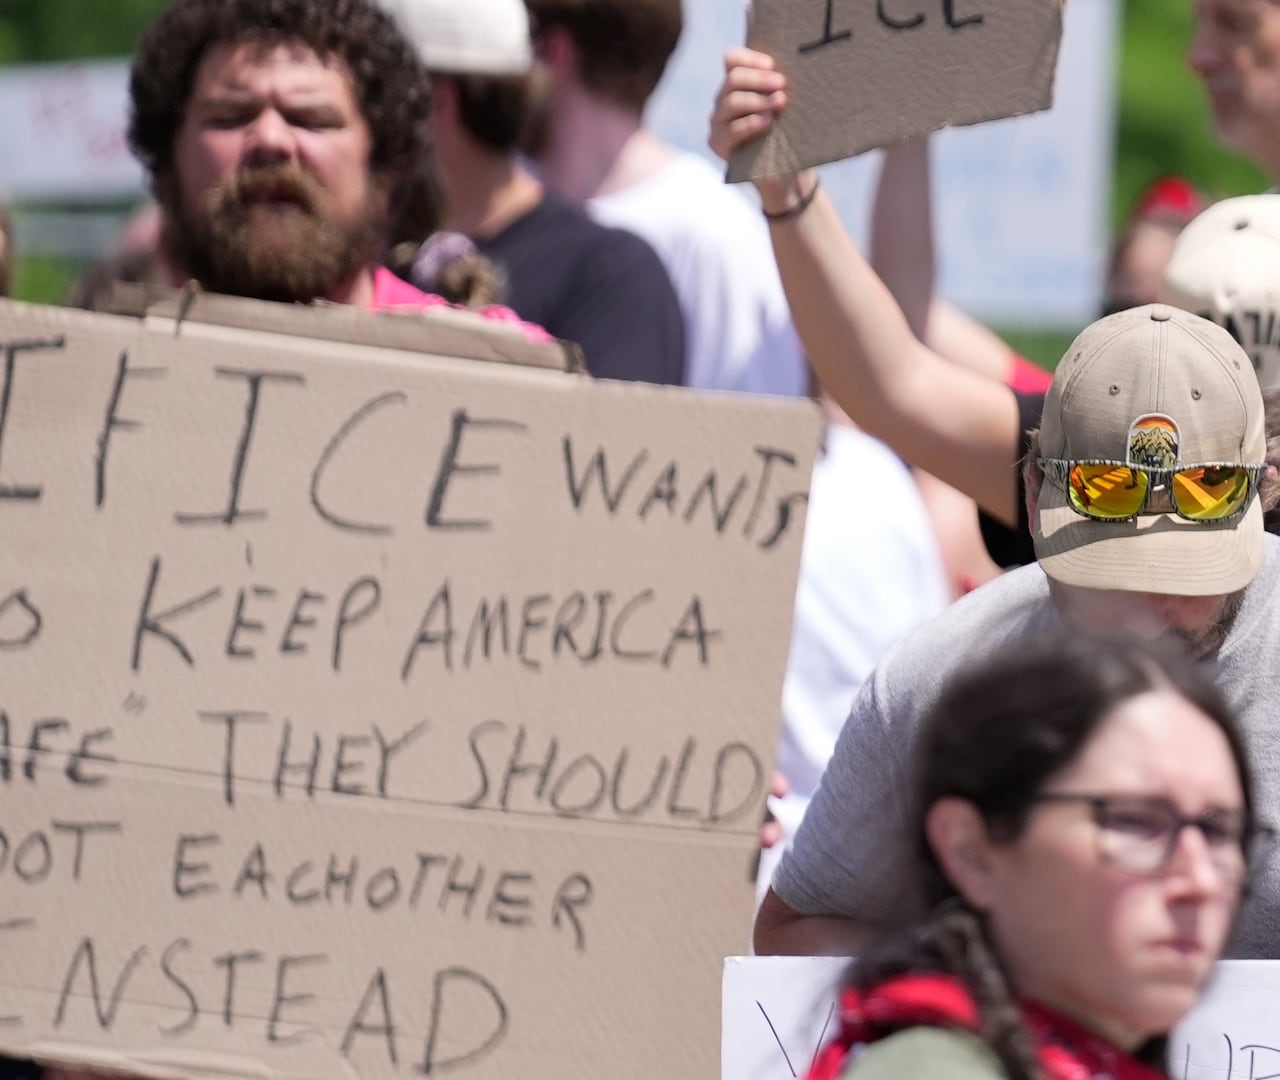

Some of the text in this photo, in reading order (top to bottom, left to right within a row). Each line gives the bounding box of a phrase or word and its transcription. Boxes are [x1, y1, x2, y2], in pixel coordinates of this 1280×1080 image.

[0, 336, 808, 550] IF ICE WANTS
[131, 556, 382, 671] KEEP
[401, 576, 723, 680] AMERICA
[198, 709, 430, 806] THEY
[465, 720, 766, 833] SHOULD
[172, 832, 595, 951] EACHOTHER
[0, 918, 509, 1076] NSTEAD
